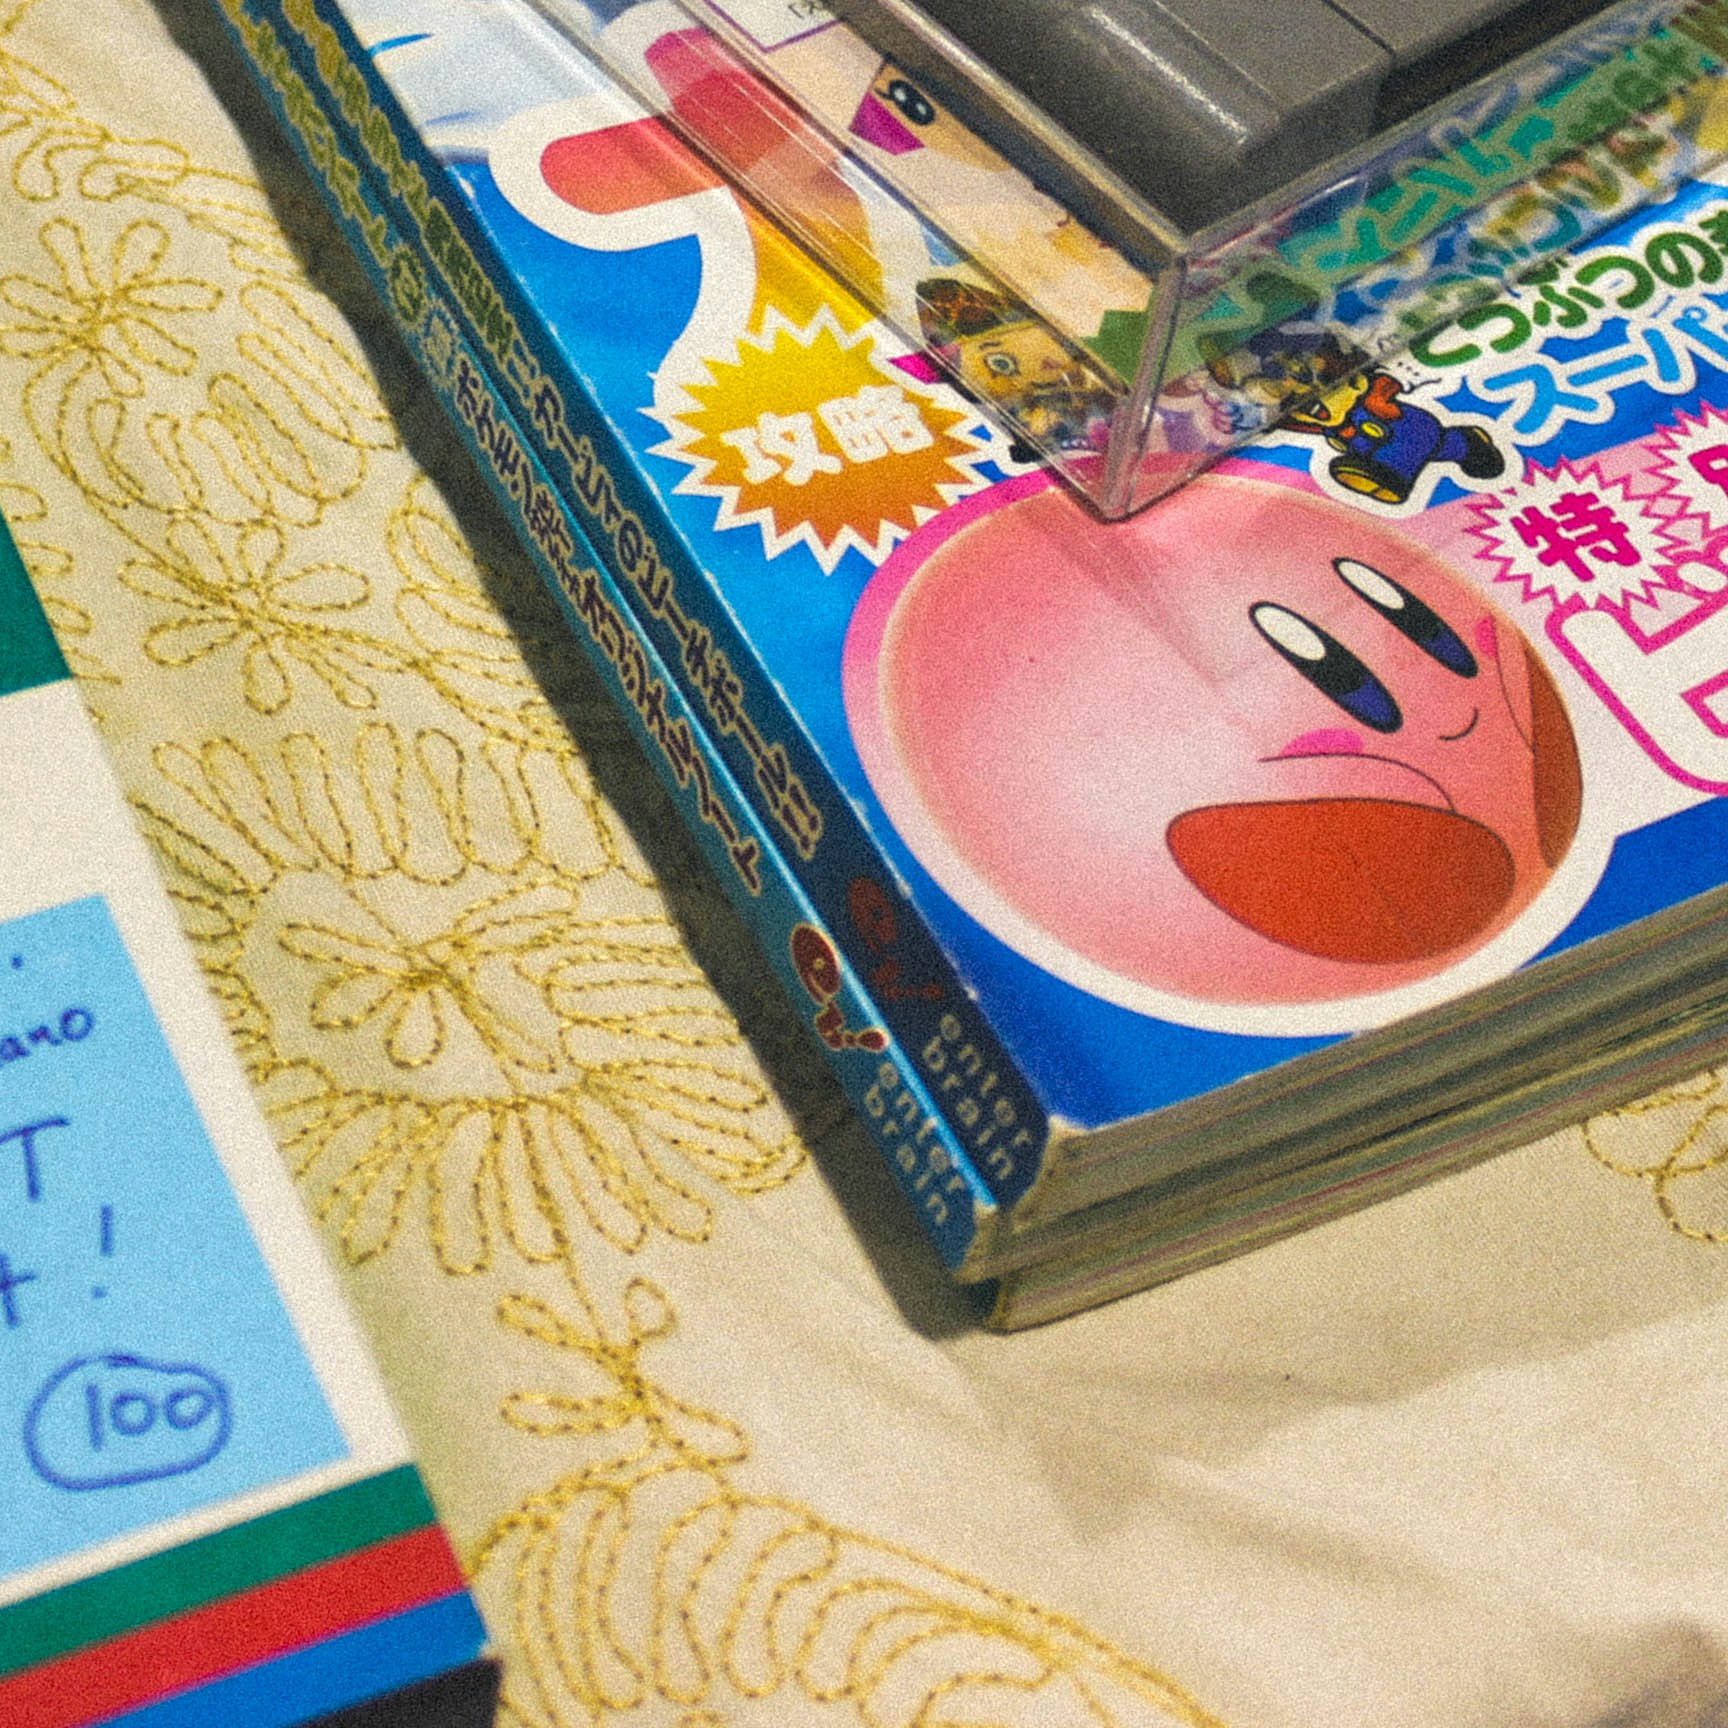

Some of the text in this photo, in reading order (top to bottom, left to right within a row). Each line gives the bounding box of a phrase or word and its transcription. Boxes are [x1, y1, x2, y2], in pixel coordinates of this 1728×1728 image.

[720, 384, 934, 486] 攻略
[922, 1035, 1014, 1180] brain
[940, 1014, 1032, 1148] enter
[865, 1084, 948, 1226] brain
[84, 1379, 217, 1454] 100
